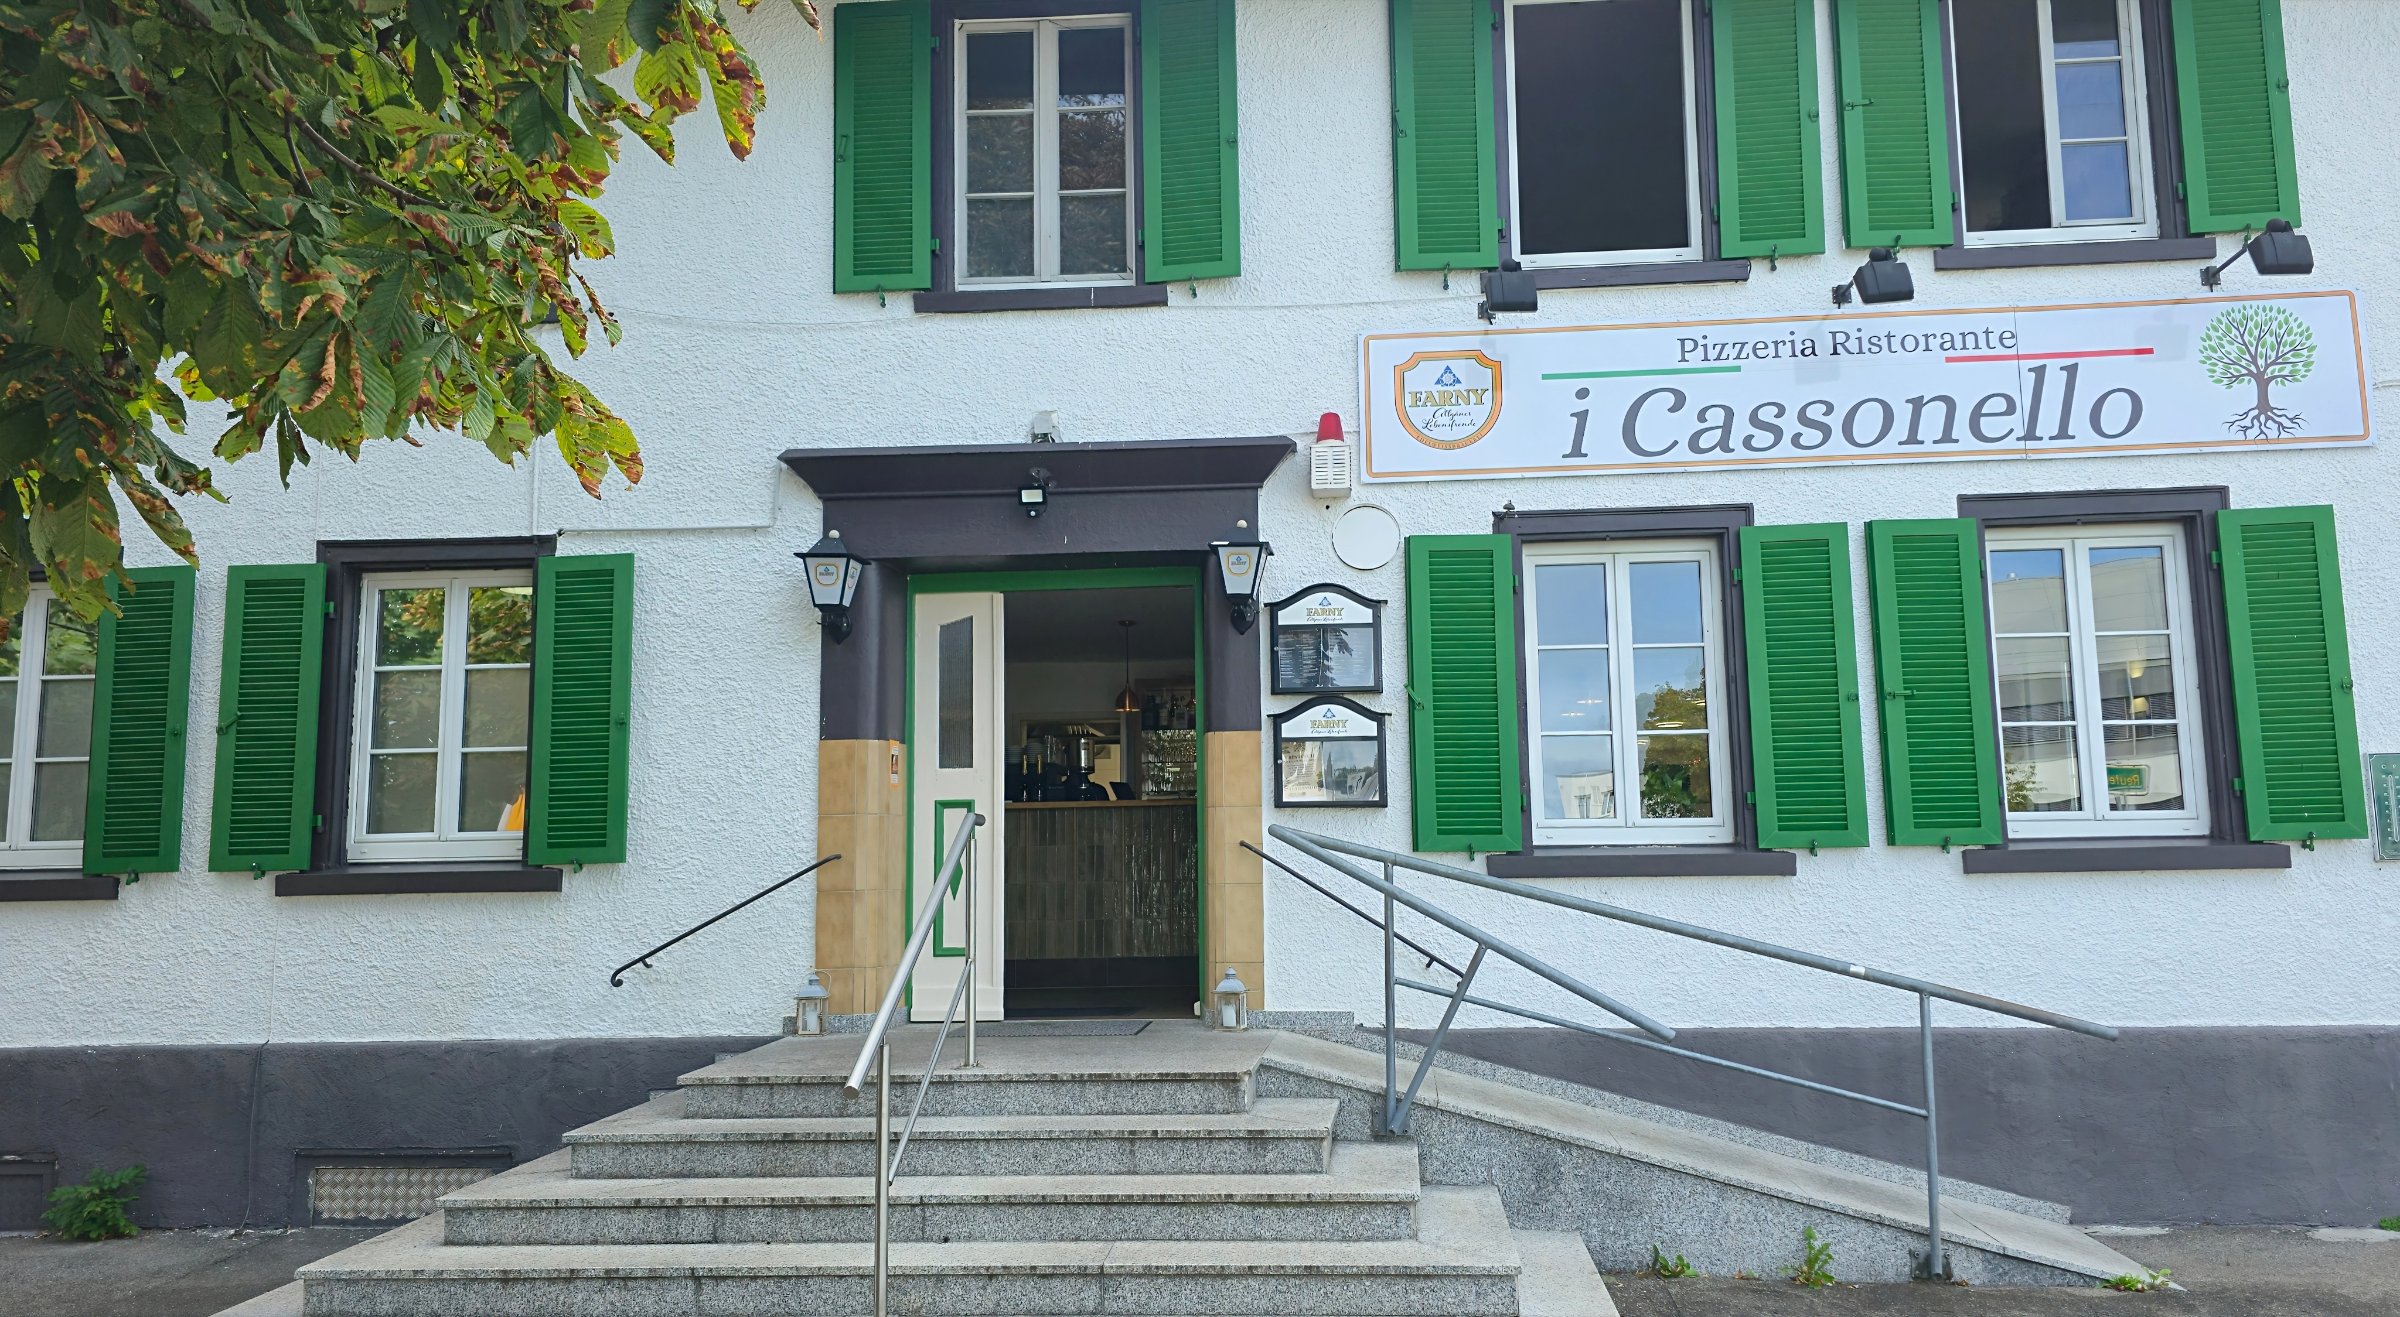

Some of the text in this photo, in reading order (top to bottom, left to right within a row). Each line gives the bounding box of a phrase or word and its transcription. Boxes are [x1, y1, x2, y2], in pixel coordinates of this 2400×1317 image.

[1677, 326, 2017, 363] Pizzeria Ristorante
[1408, 388, 1489, 408] FARNY
[1562, 363, 2144, 459] i Cassonello
[1306, 607, 1345, 617] FARNY
[1310, 719, 1349, 729] FARNY
